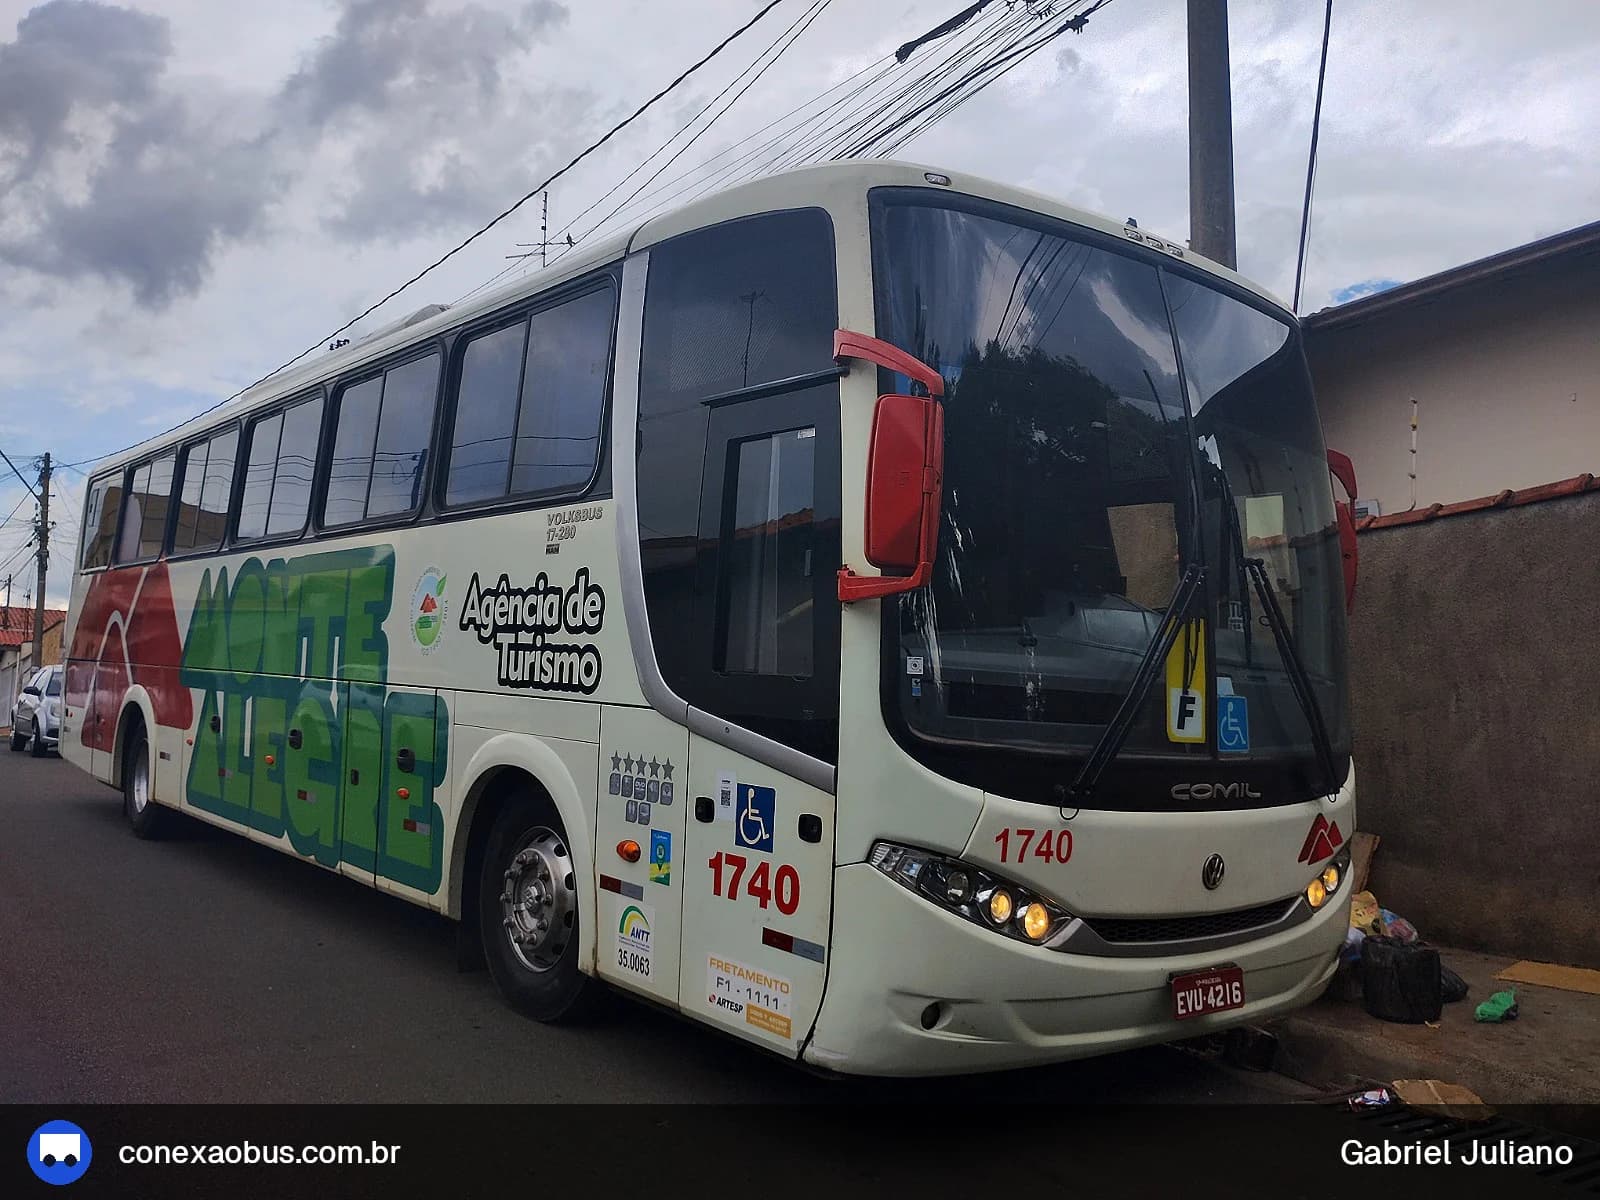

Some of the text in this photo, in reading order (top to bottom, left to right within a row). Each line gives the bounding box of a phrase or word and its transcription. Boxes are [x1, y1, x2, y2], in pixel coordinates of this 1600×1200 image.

[547, 507, 603, 526] VOLKSBUS
[180, 545, 395, 690] MONTE
[460, 574, 562, 642] Agência
[564, 570, 603, 632] de
[496, 632, 600, 691] Turismo
[1176, 696, 1195, 730] F
[186, 688, 448, 893] ALEGRE
[1170, 782, 1262, 800] COMIL
[995, 828, 1073, 864] 1740
[708, 851, 800, 916] 1740
[631, 926, 650, 943] ANTT
[618, 948, 650, 977] 35.0063
[709, 957, 790, 994] FRETAMENTO
[716, 996, 744, 1014] ARTESP
